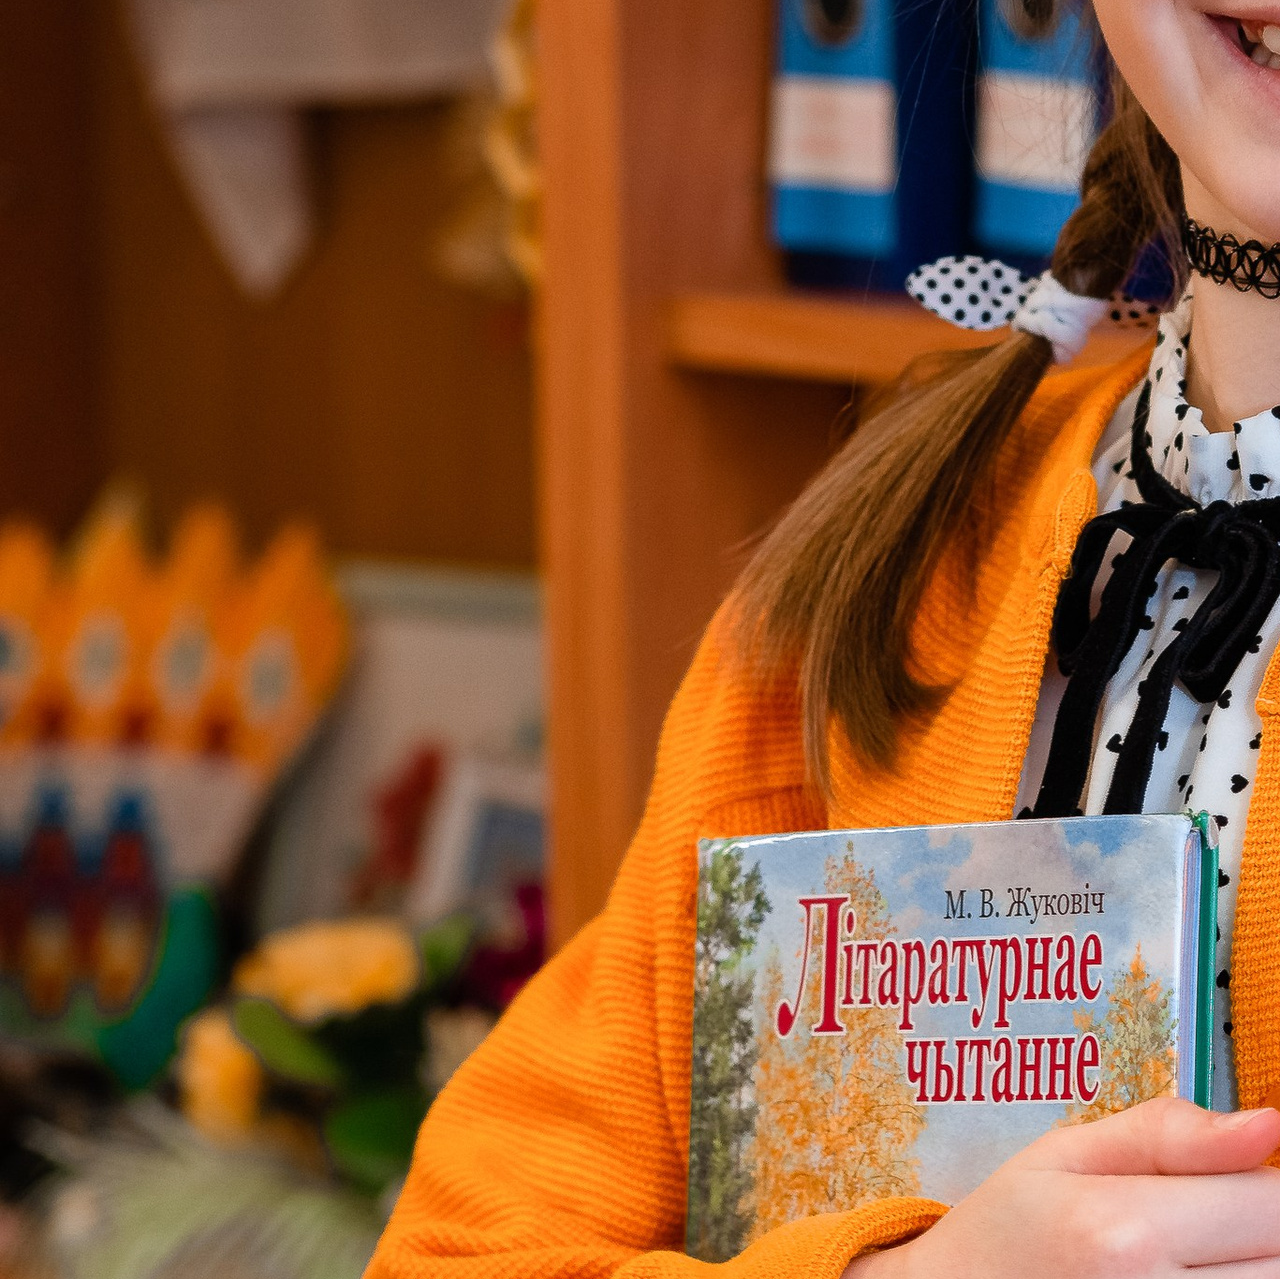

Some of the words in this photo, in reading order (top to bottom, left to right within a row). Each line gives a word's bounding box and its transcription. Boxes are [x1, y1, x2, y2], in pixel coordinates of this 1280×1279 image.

[943, 889, 972, 920] М.
[979, 888, 1000, 919] В.
[1005, 882, 1106, 925] Жуковіч
[776, 896, 1103, 1036] Літаратурнае
[904, 1034, 1100, 1103] чытанне
